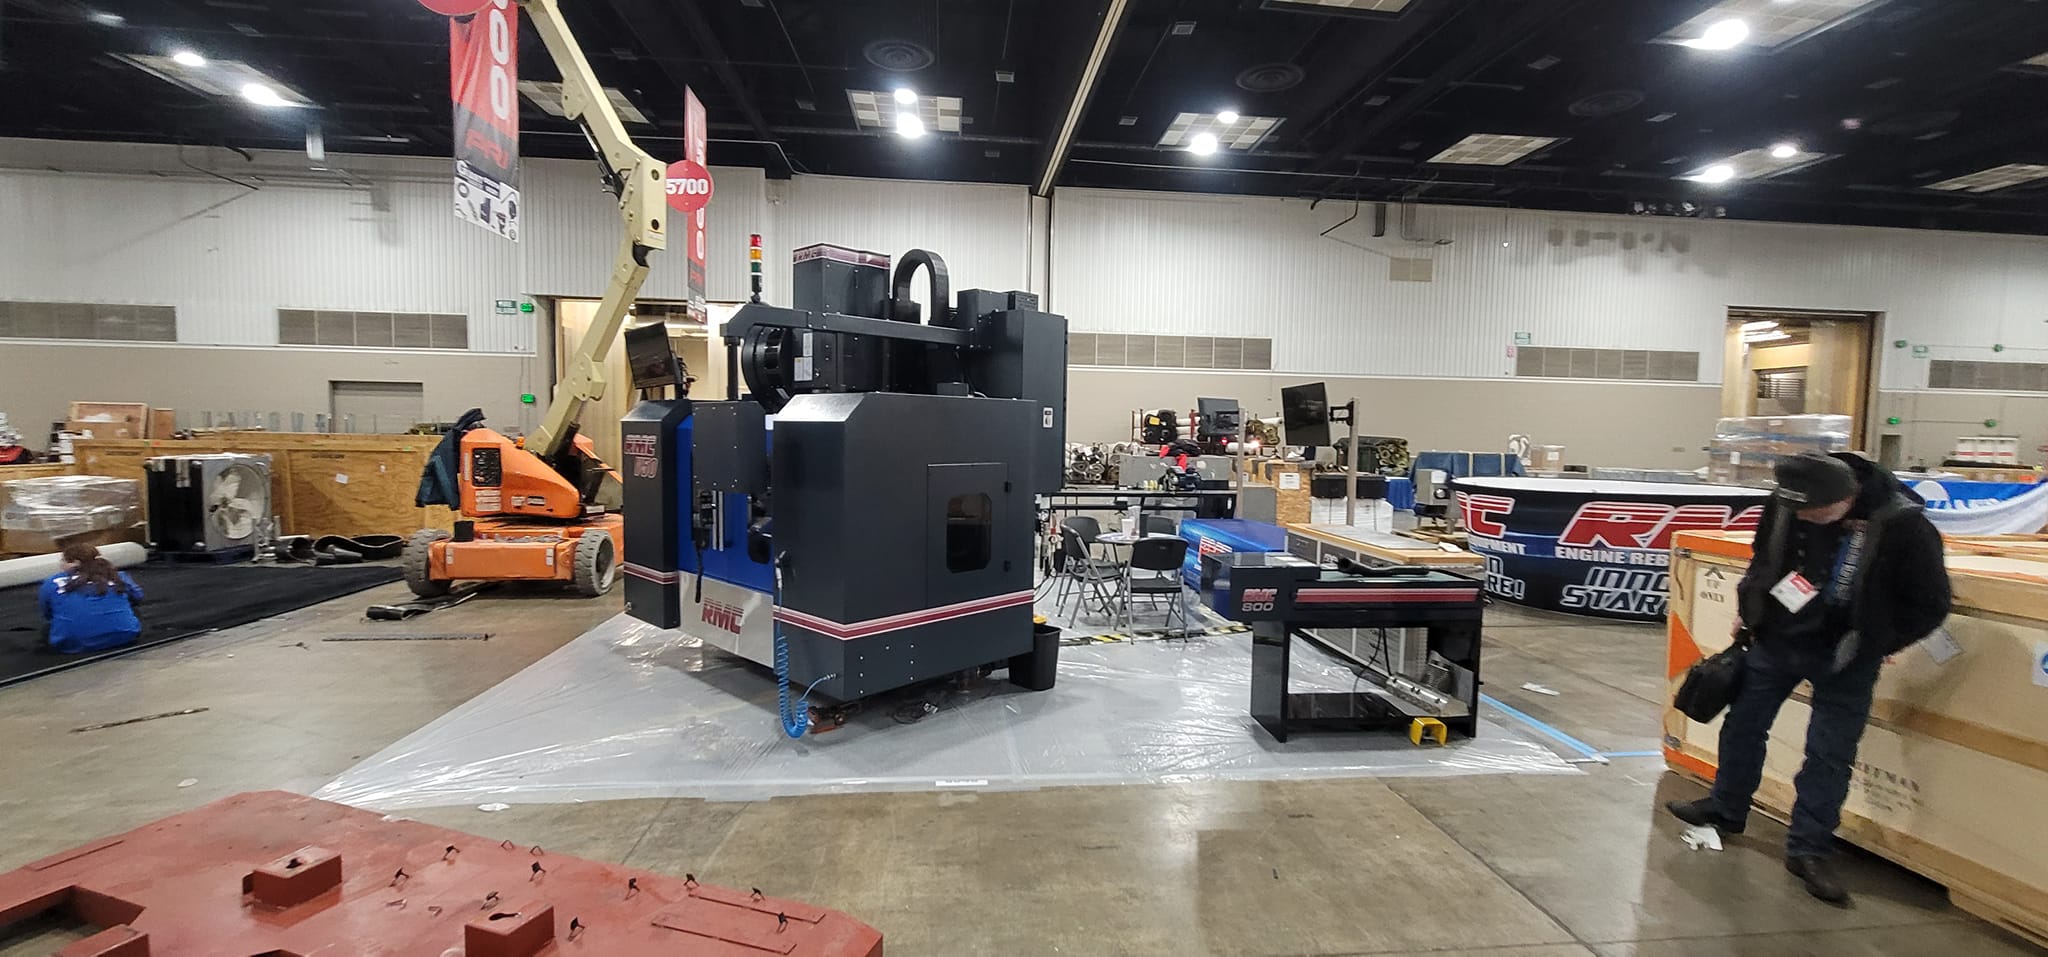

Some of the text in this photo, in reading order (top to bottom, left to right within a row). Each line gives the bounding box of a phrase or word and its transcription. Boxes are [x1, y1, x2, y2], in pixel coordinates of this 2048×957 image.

[488, 0, 509, 120] 00
[666, 178, 709, 194] 5700
[624, 434, 657, 457] RMC
[1555, 545, 1670, 567] ENGINE REB
[1242, 588, 1278, 602] RMC
[1484, 574, 1526, 600] RE!
[1242, 602, 1274, 612] 800
[1560, 585, 1671, 615] STAR
[702, 597, 745, 635] RMC
